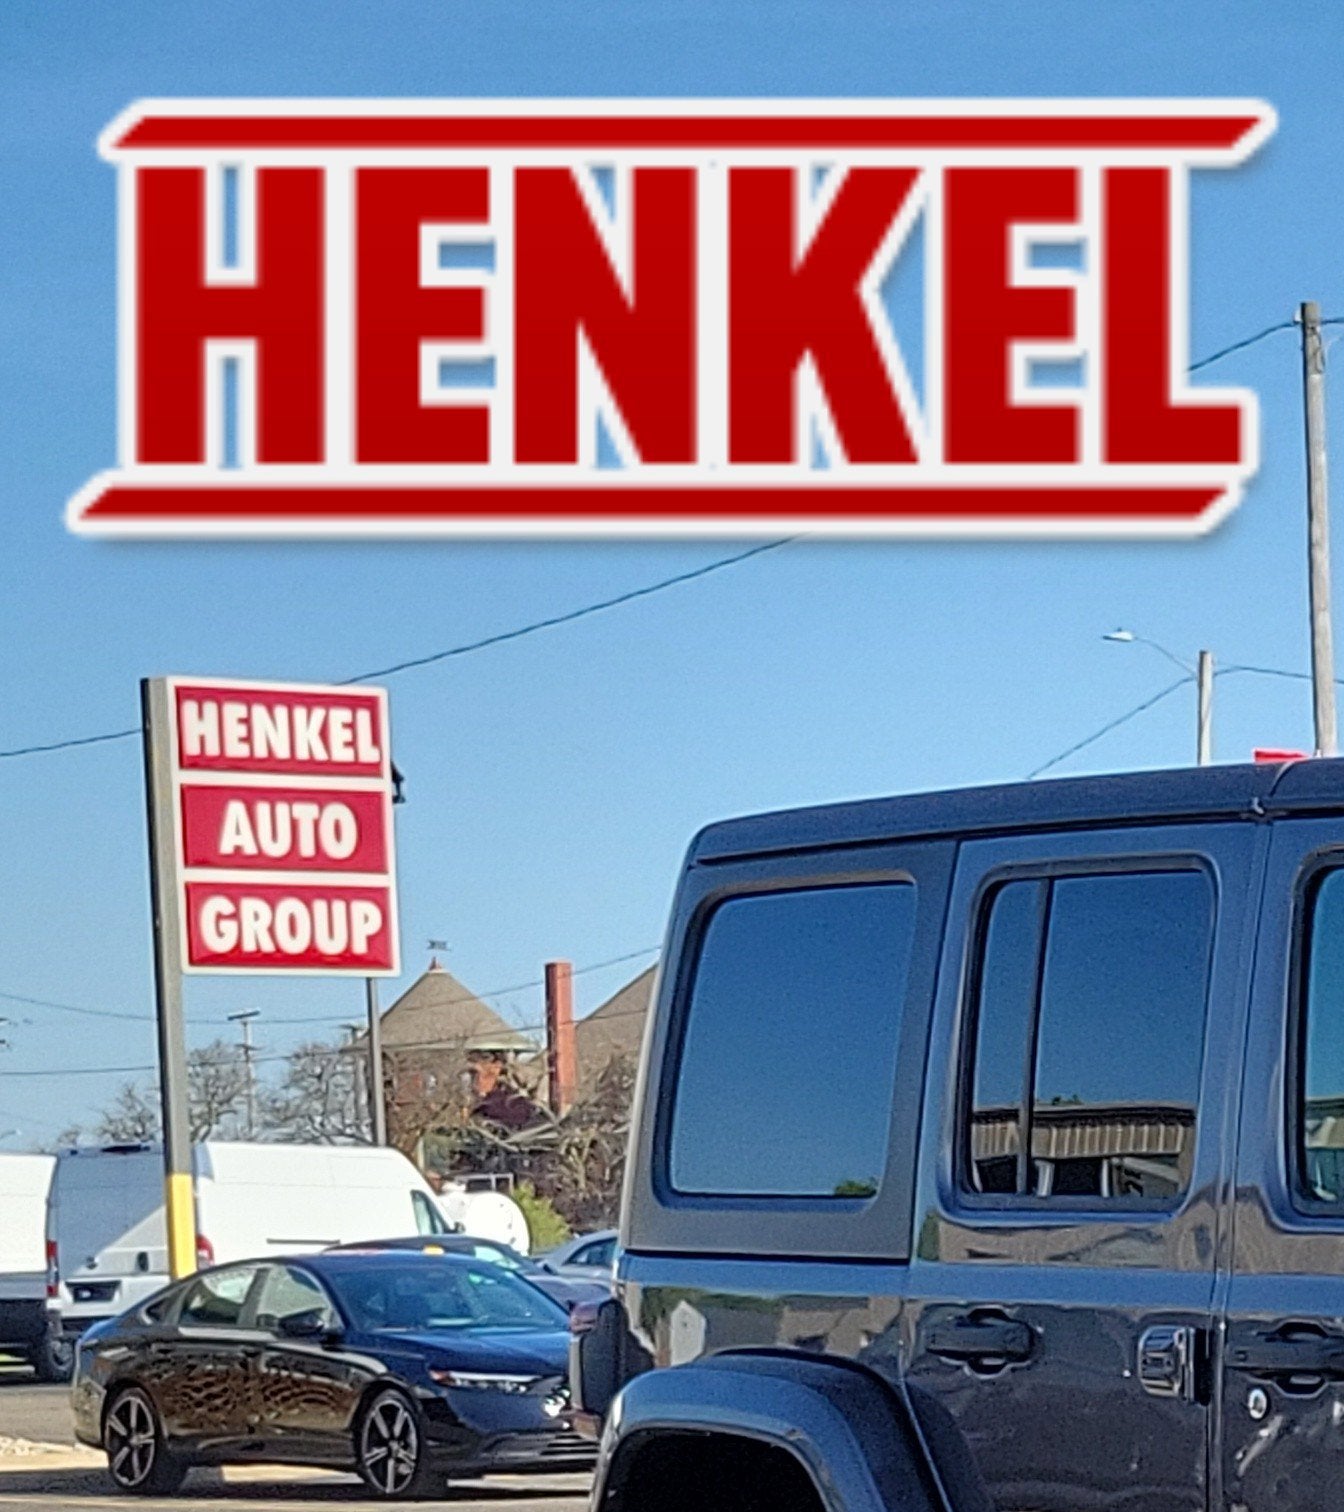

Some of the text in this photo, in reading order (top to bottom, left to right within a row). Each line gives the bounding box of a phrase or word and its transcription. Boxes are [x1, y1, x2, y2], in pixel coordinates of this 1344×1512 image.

[180, 699, 382, 764] HENKEL
[219, 801, 358, 859] AUTO
[200, 895, 383, 955] GROUP
